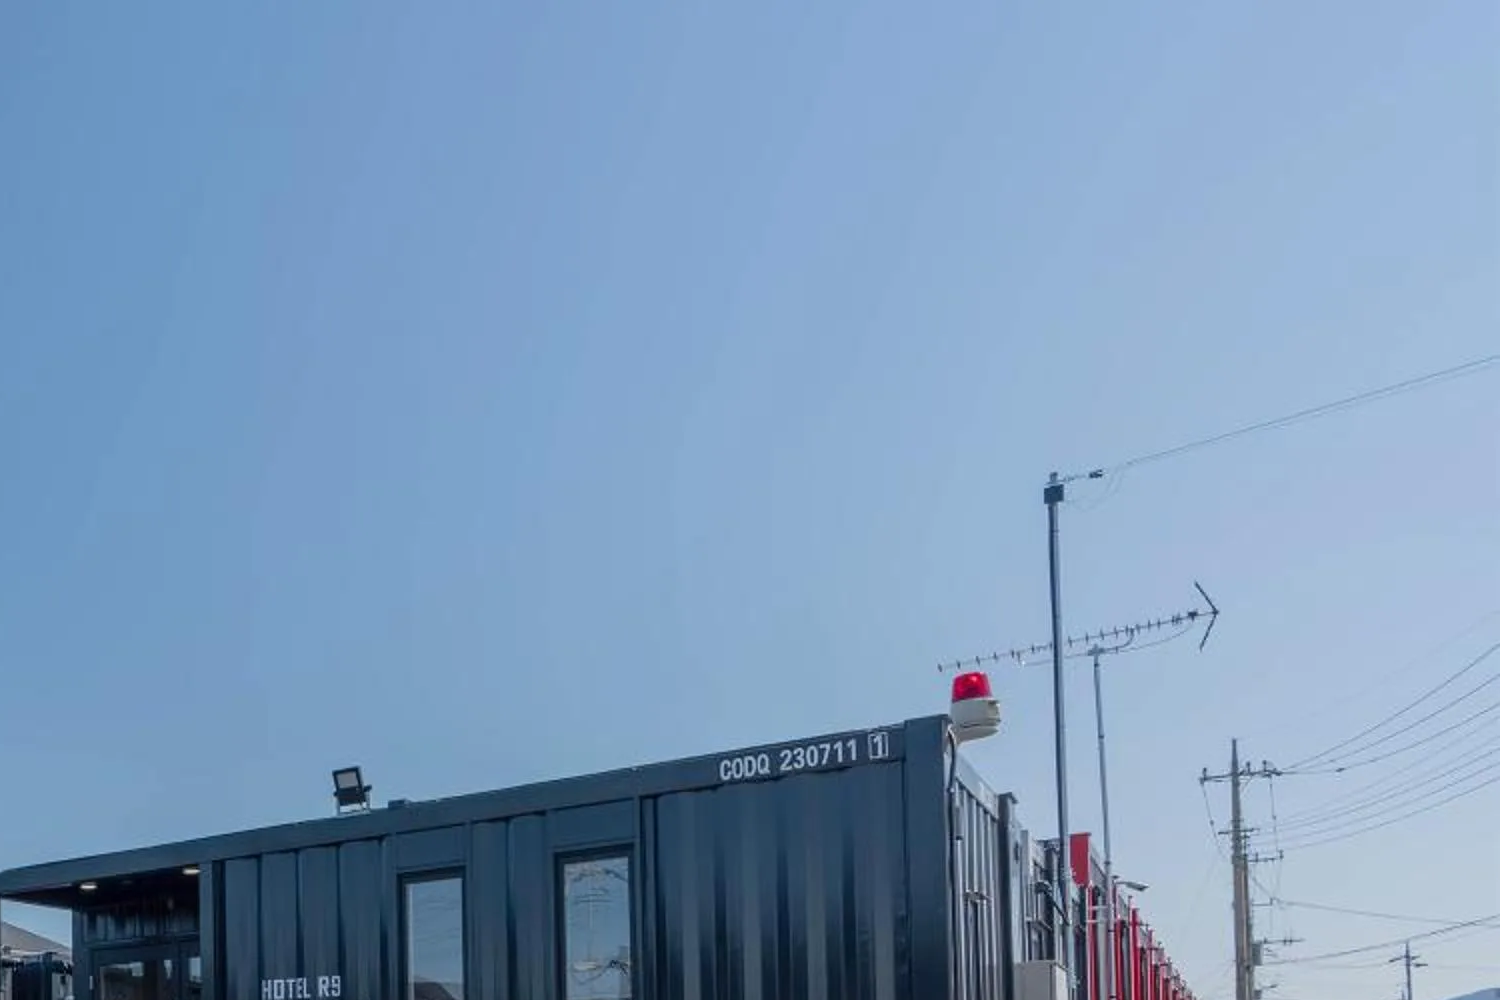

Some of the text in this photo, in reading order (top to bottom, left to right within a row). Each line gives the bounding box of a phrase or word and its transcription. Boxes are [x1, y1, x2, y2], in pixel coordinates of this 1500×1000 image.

[719, 753, 771, 781] CODQ
[779, 739, 857, 772] 230711
[261, 975, 341, 1000] HOTEL R9
